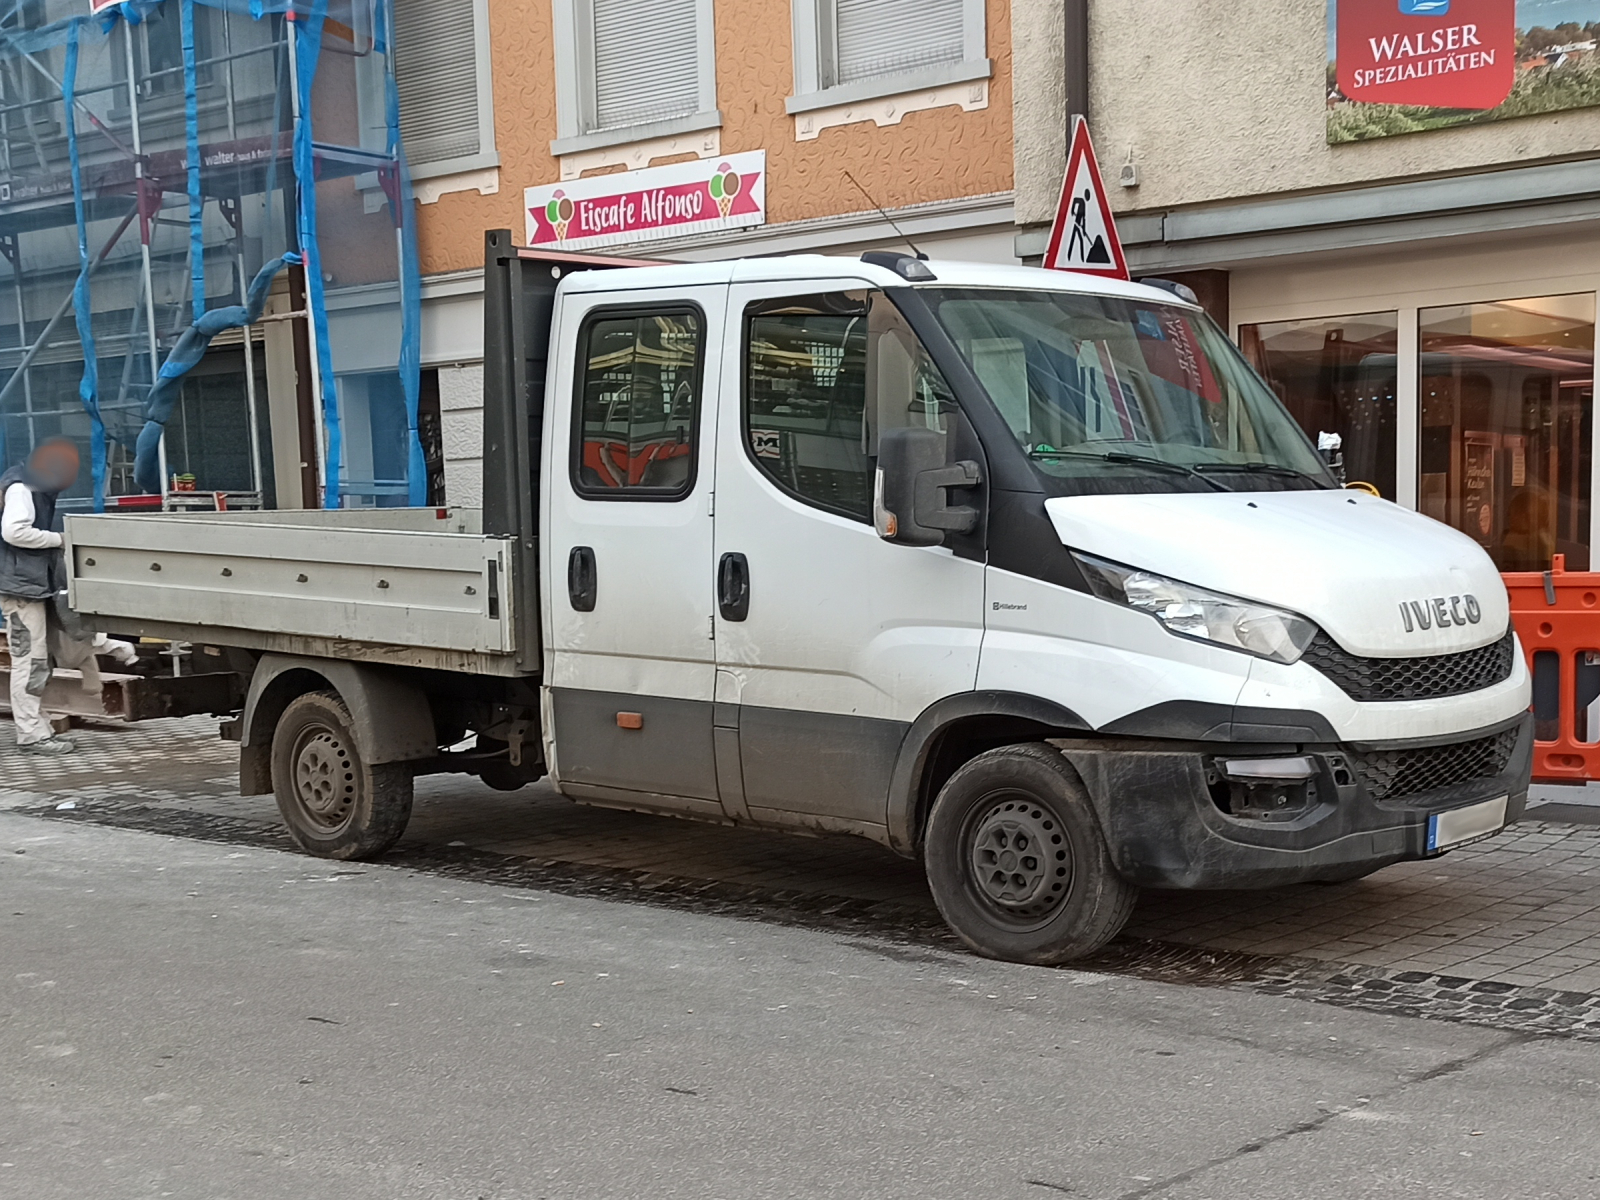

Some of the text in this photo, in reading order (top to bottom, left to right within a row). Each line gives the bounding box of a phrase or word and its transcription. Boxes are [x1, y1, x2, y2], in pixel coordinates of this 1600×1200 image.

[1368, 24, 1482, 63] WALSER
[1353, 49, 1496, 89] SPEZIALITÄTEN
[580, 190, 702, 233] Eiscafe Alfonso
[1398, 594, 1481, 632] IVECO
